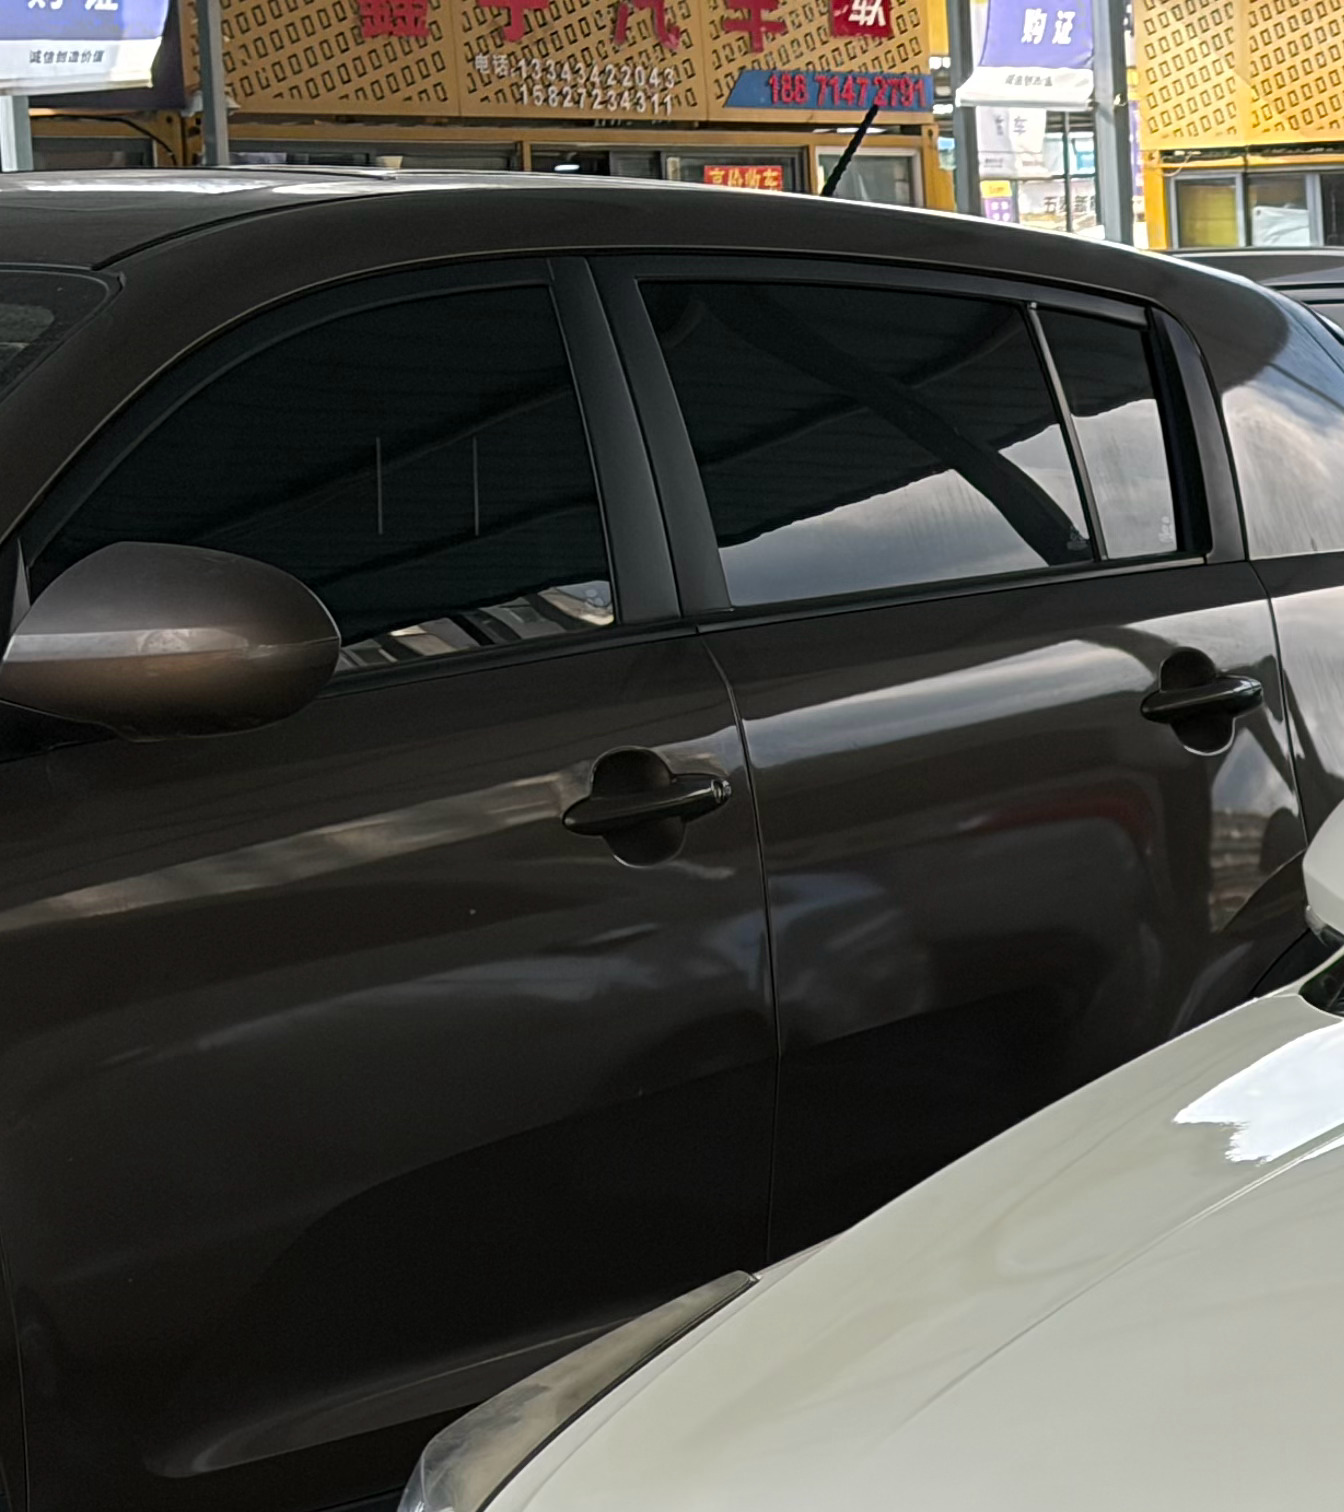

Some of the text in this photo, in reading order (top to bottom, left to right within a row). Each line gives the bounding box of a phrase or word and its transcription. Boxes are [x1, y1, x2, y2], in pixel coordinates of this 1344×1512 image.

[768, 73, 927, 107] 188 7147 2791
